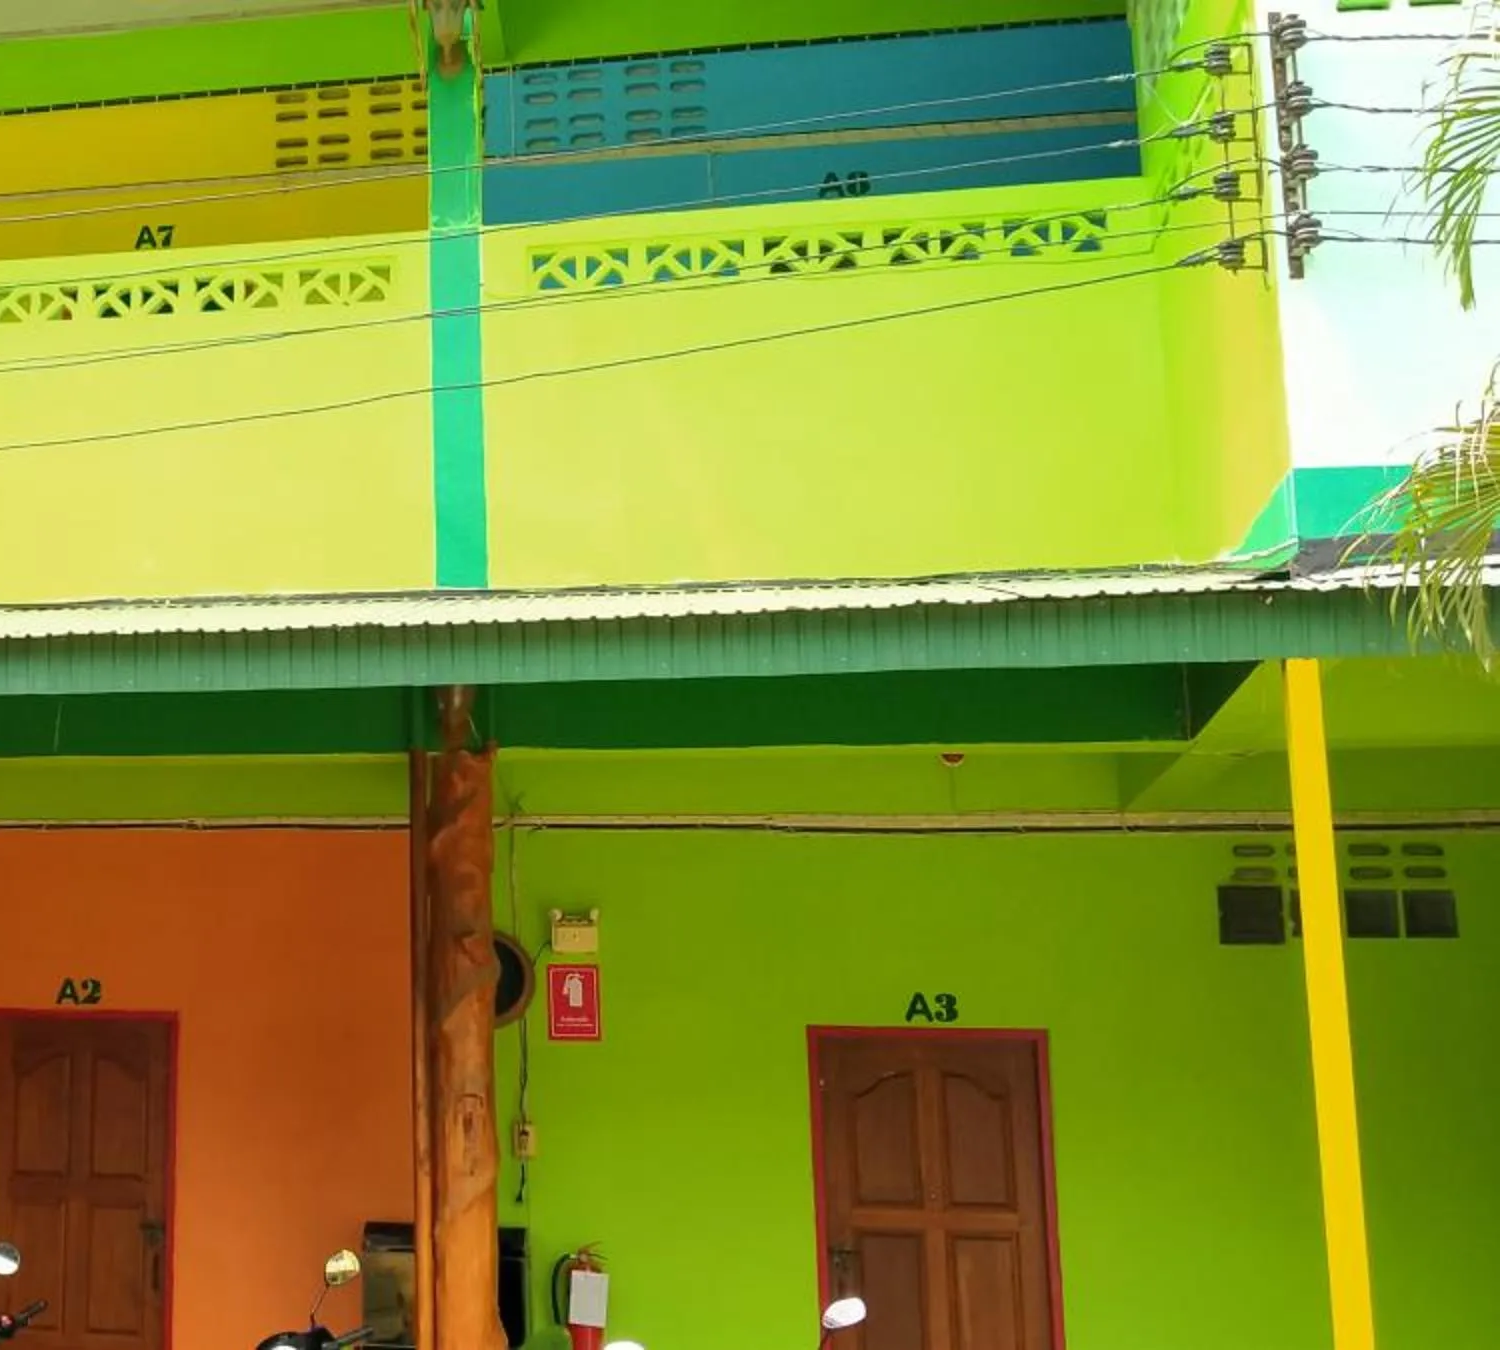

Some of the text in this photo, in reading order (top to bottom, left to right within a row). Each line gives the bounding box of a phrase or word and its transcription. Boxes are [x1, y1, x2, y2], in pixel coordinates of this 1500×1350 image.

[134, 224, 175, 251] A7
[55, 977, 102, 1005] A2
[905, 991, 959, 1023] A3
